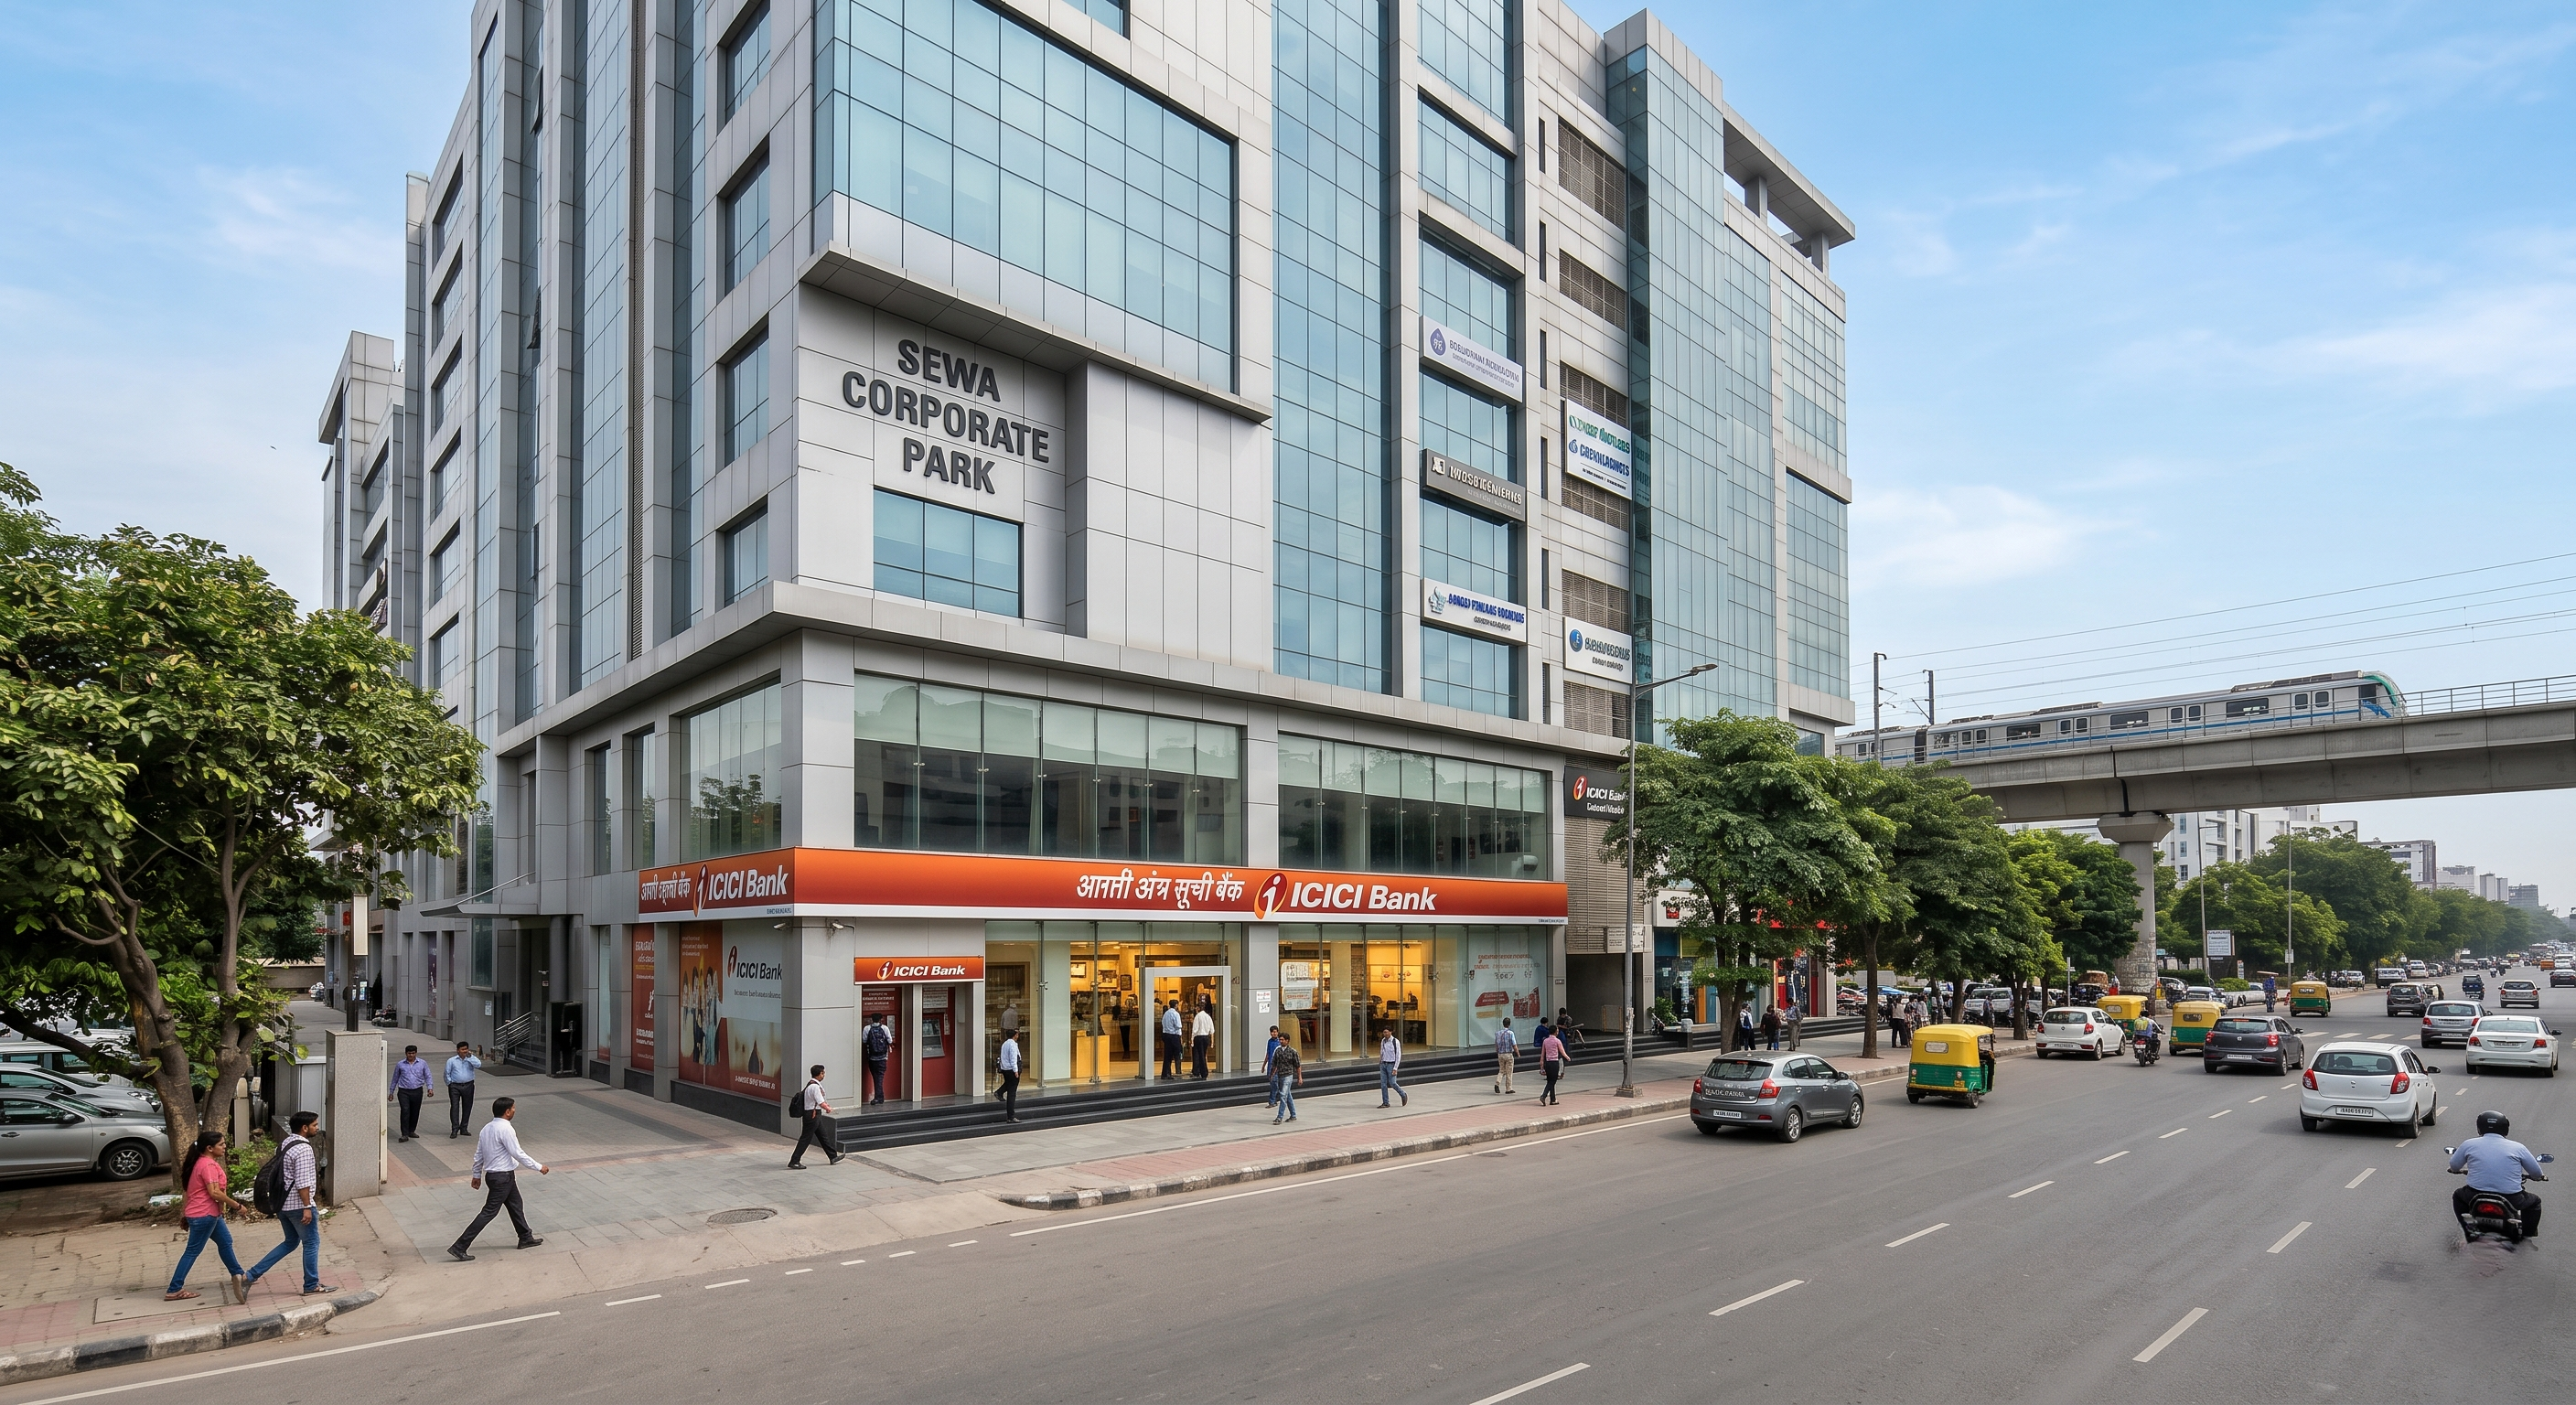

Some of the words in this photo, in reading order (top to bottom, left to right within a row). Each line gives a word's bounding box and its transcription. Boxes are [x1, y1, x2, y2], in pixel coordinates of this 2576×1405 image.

[897, 339, 1001, 402] SEWA
[843, 370, 1049, 464] CORPORATE
[903, 436, 995, 494] PARK
[1586, 787, 1607, 800] ICICI
[709, 870, 745, 901] ICICI
[746, 864, 789, 898] Bank
[1290, 882, 1364, 909] ICICI
[1368, 885, 1437, 911] Bank
[736, 961, 759, 979] ICICI
[759, 962, 782, 980] Bank
[894, 965, 928, 977] ICICI
[930, 964, 965, 976] Bank
